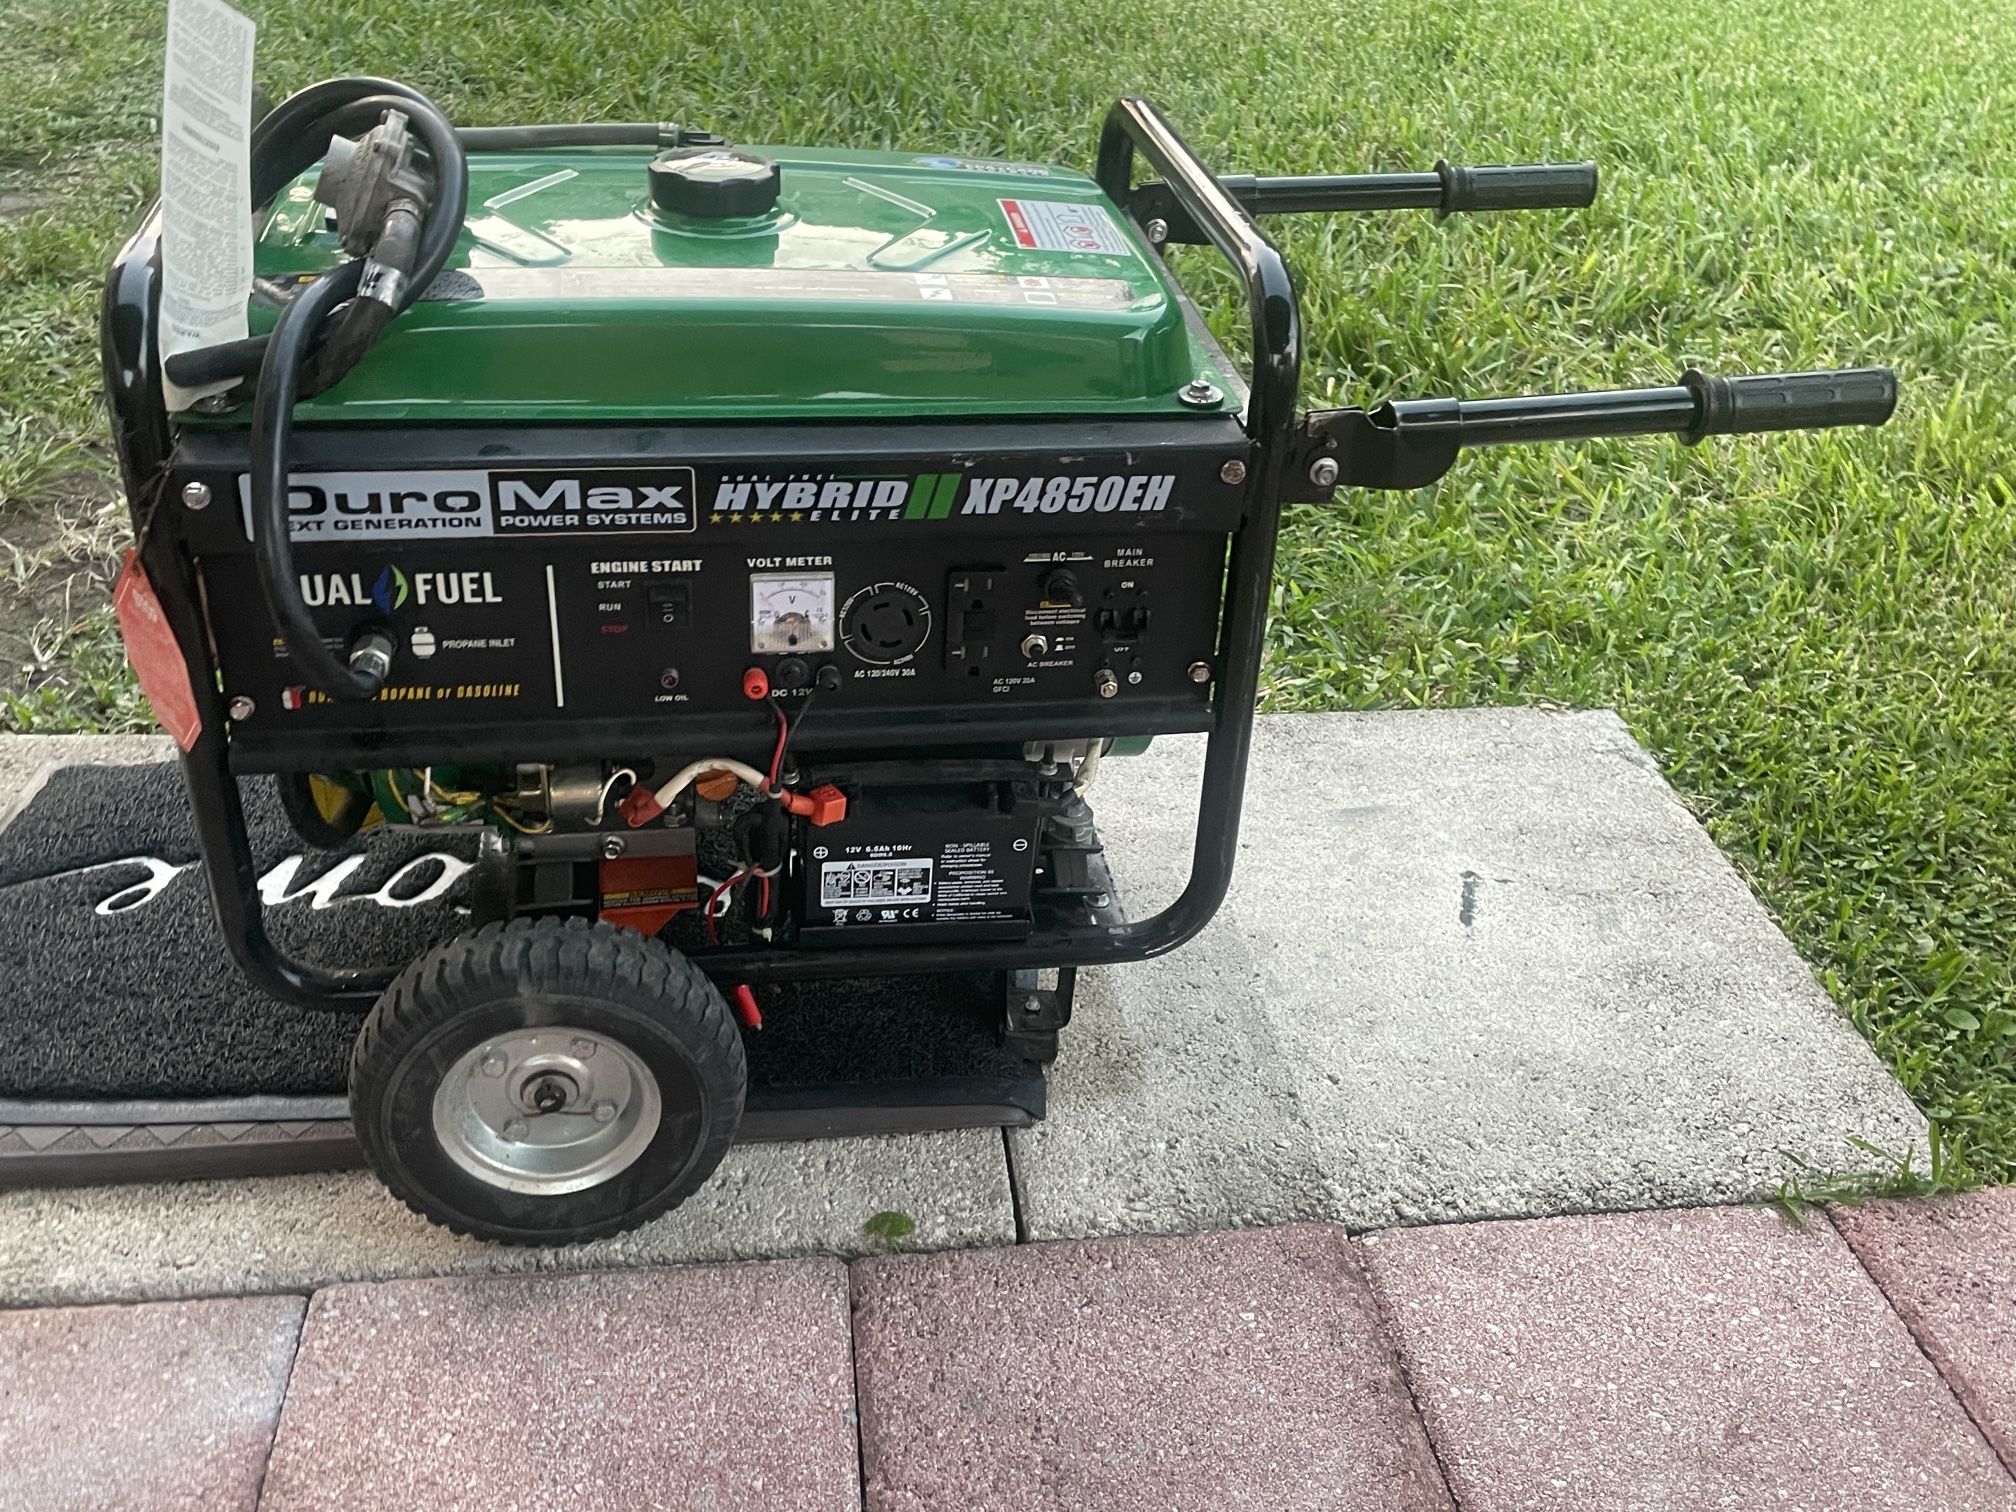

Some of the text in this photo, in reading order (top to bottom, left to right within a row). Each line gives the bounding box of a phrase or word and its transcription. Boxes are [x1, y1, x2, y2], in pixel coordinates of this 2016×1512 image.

[498, 479, 685, 512] Max
[713, 480, 909, 511] HYBRID
[961, 475, 1176, 516] XP4850EH
[500, 511, 688, 527] POWER SYSTEMS
[809, 509, 902, 522] ELITE
[288, 516, 482, 532] EXT GENERATION
[1052, 551, 1067, 562] AC
[1116, 548, 1144, 557] MAIN
[590, 559, 703, 574] ENGINE START
[746, 555, 833, 568] VOLT METER
[1103, 558, 1155, 568] BREAKER
[300, 571, 503, 606] UAL FUEL
[597, 580, 632, 589] START
[1120, 581, 1135, 589] ON
[598, 603, 622, 611] RUN
[442, 637, 516, 649] PROPANE INLET
[372, 686, 432, 701] ROPANE
[771, 687, 814, 698] DC 12V
